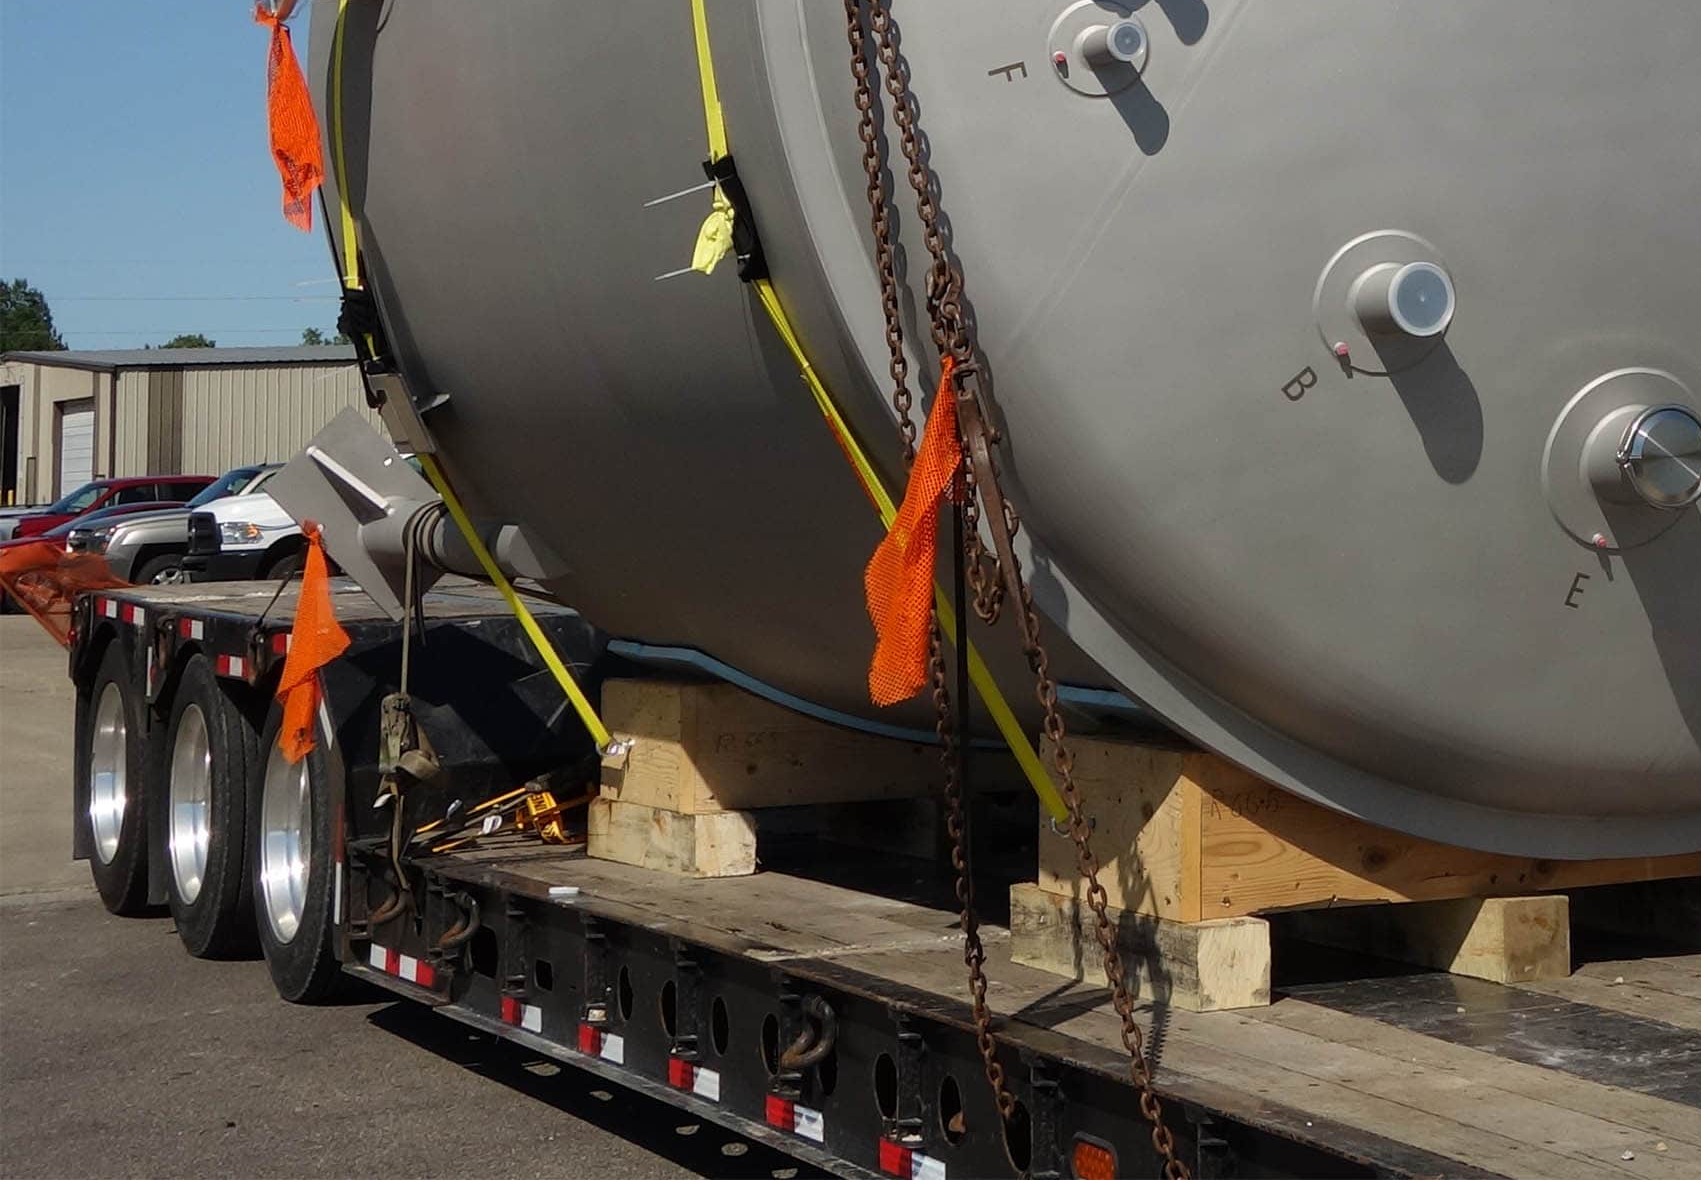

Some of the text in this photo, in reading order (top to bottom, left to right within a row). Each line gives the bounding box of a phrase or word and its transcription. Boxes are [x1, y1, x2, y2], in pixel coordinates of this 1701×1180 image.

[987, 61, 1028, 82] F
[1281, 365, 1318, 402] B
[1564, 571, 1591, 609] E
